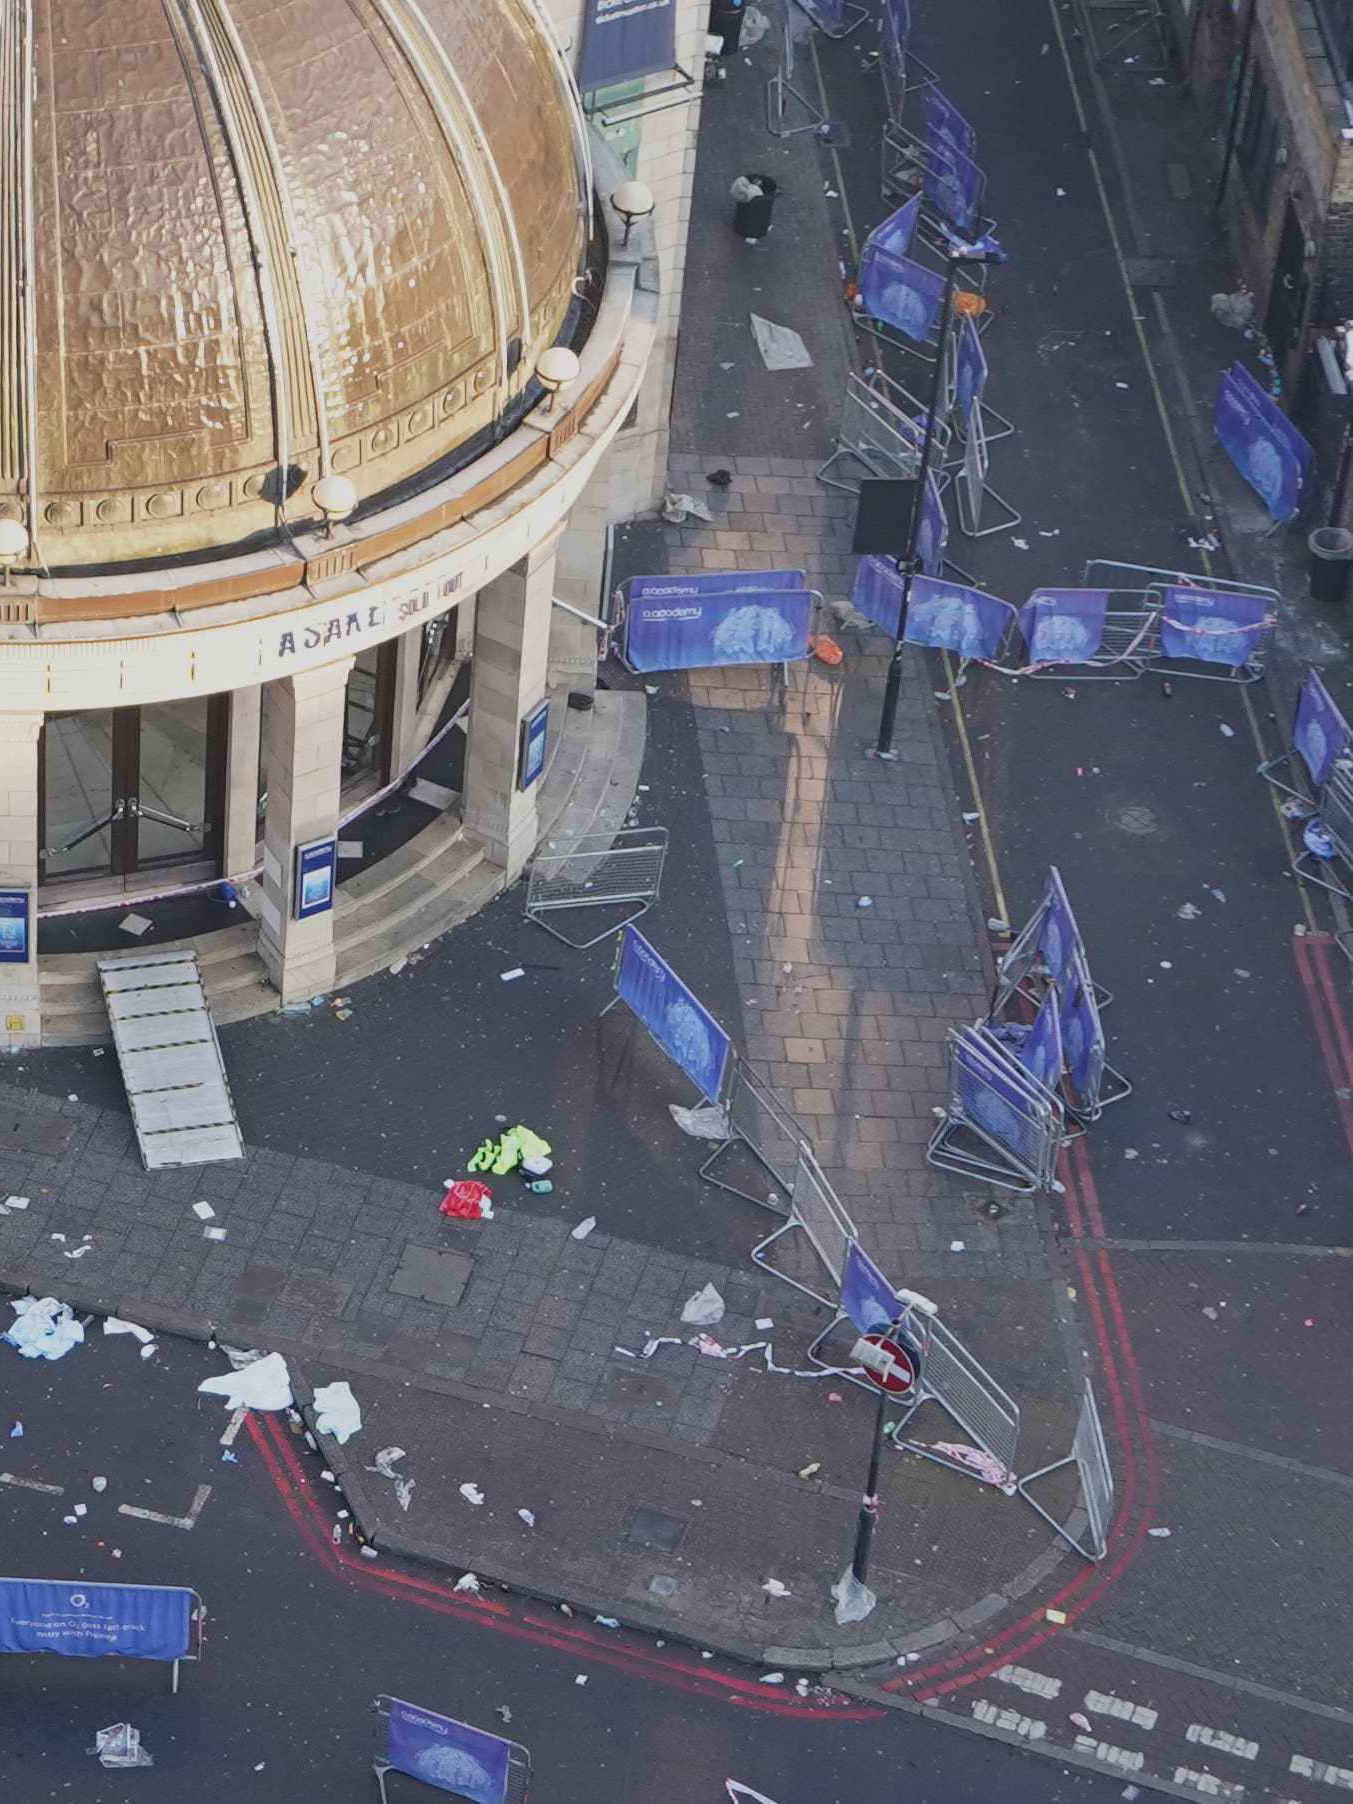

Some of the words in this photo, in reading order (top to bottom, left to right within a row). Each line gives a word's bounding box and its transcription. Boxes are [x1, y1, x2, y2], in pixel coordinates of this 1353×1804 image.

[399, 591, 430, 622] SOLD
[10, 1616, 52, 1631] Everyone
[53, 1621, 67, 1629] on
[36, 1630, 60, 1639] entry
